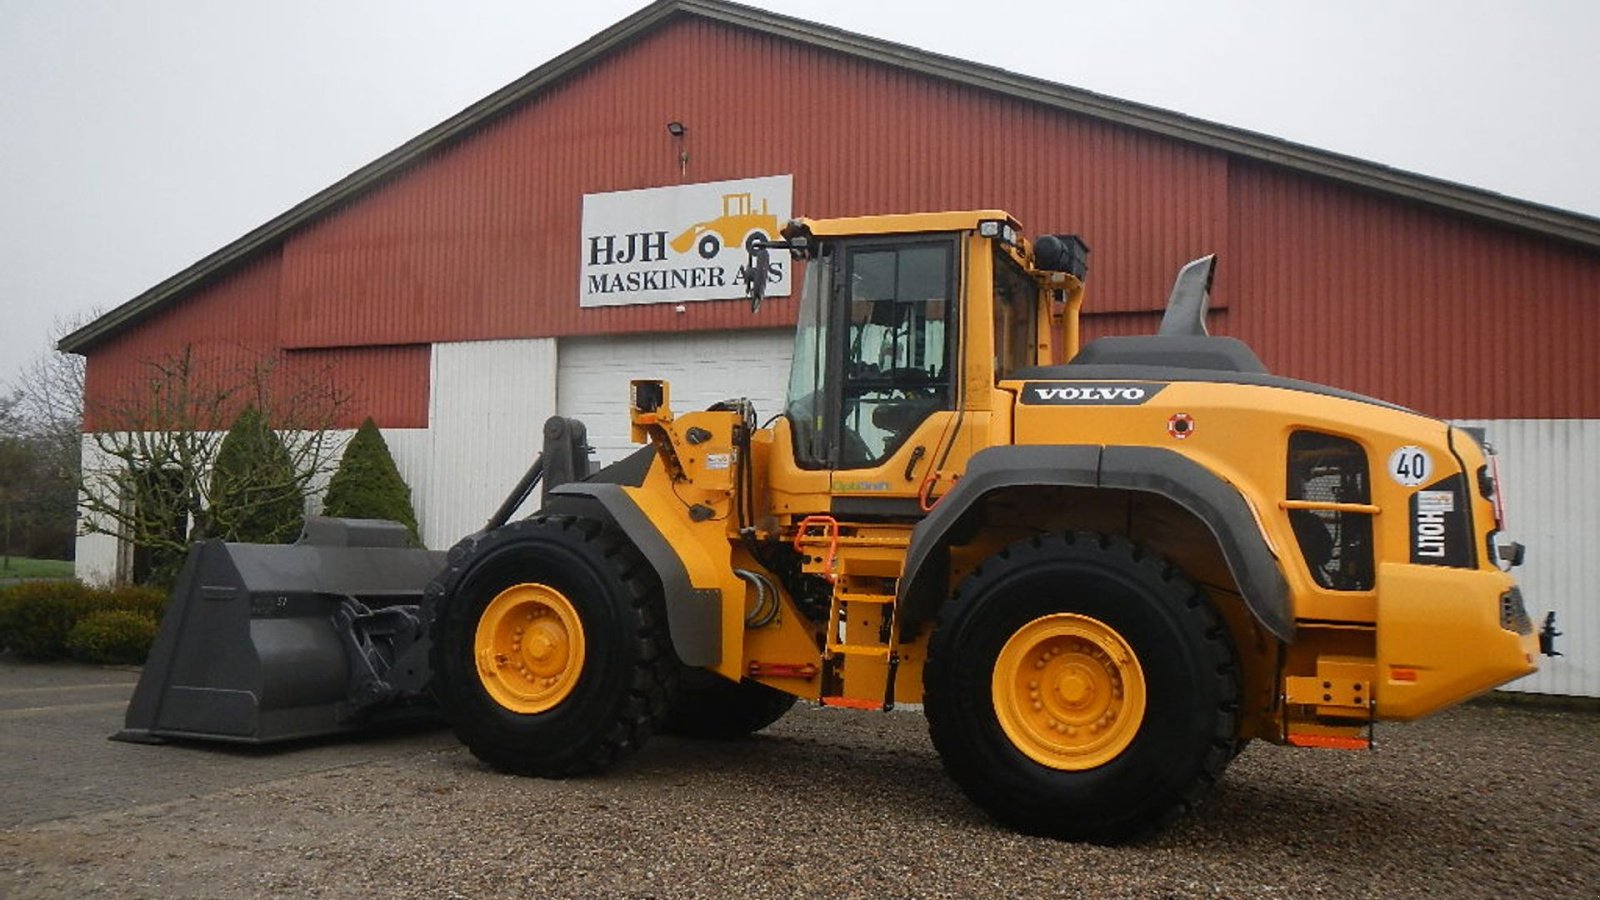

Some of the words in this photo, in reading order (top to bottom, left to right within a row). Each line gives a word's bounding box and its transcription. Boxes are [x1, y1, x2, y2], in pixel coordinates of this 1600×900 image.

[587, 231, 669, 266] HJH
[587, 267, 726, 294] MASKINER
[732, 262, 783, 286] AS
[1035, 387, 1145, 400] VOLVO
[1397, 453, 1425, 479] 40
[1417, 511, 1445, 557] L110H
